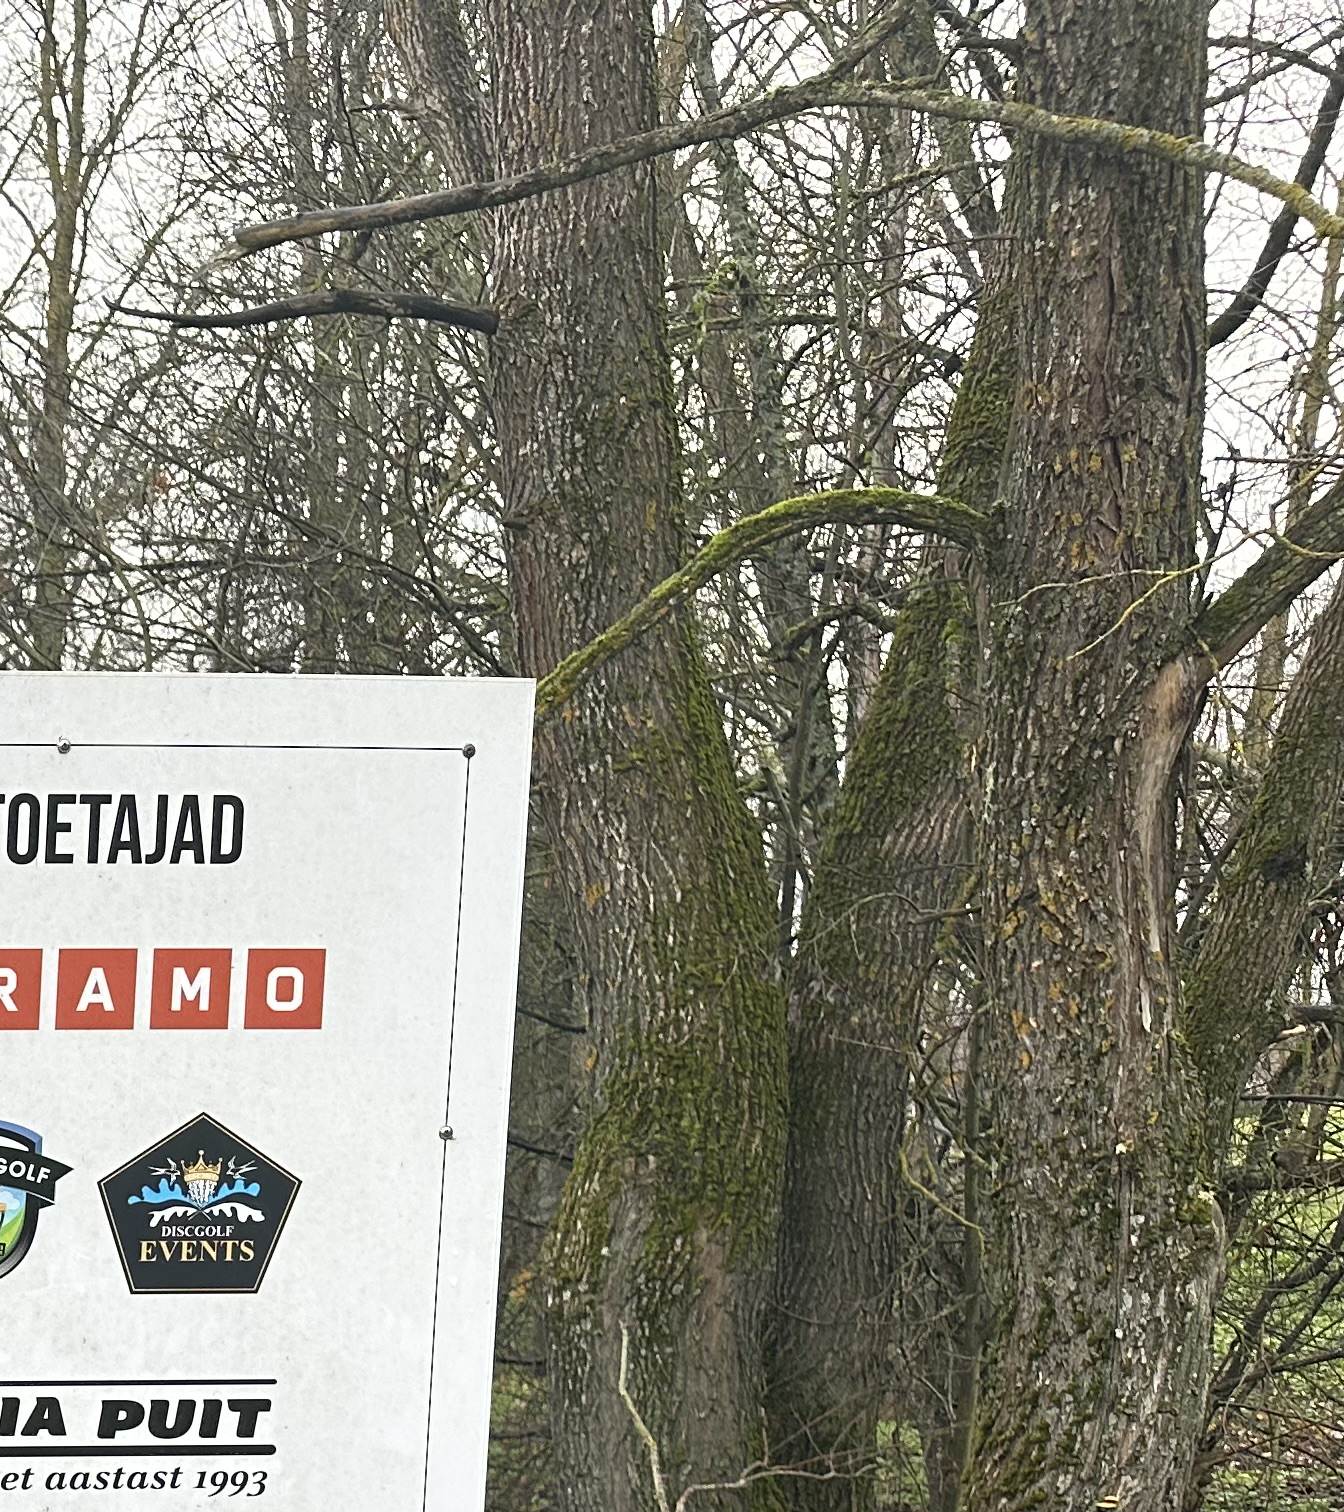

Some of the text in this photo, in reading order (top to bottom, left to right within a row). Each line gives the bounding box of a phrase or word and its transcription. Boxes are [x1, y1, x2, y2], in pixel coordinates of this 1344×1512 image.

[161, 1225, 235, 1237] DISCGOLF
[138, 1239, 255, 1262] EVENTS
[96, 1398, 272, 1440] PUIT
[45, 1465, 182, 1491] aastast
[194, 1470, 268, 1498] 1993
